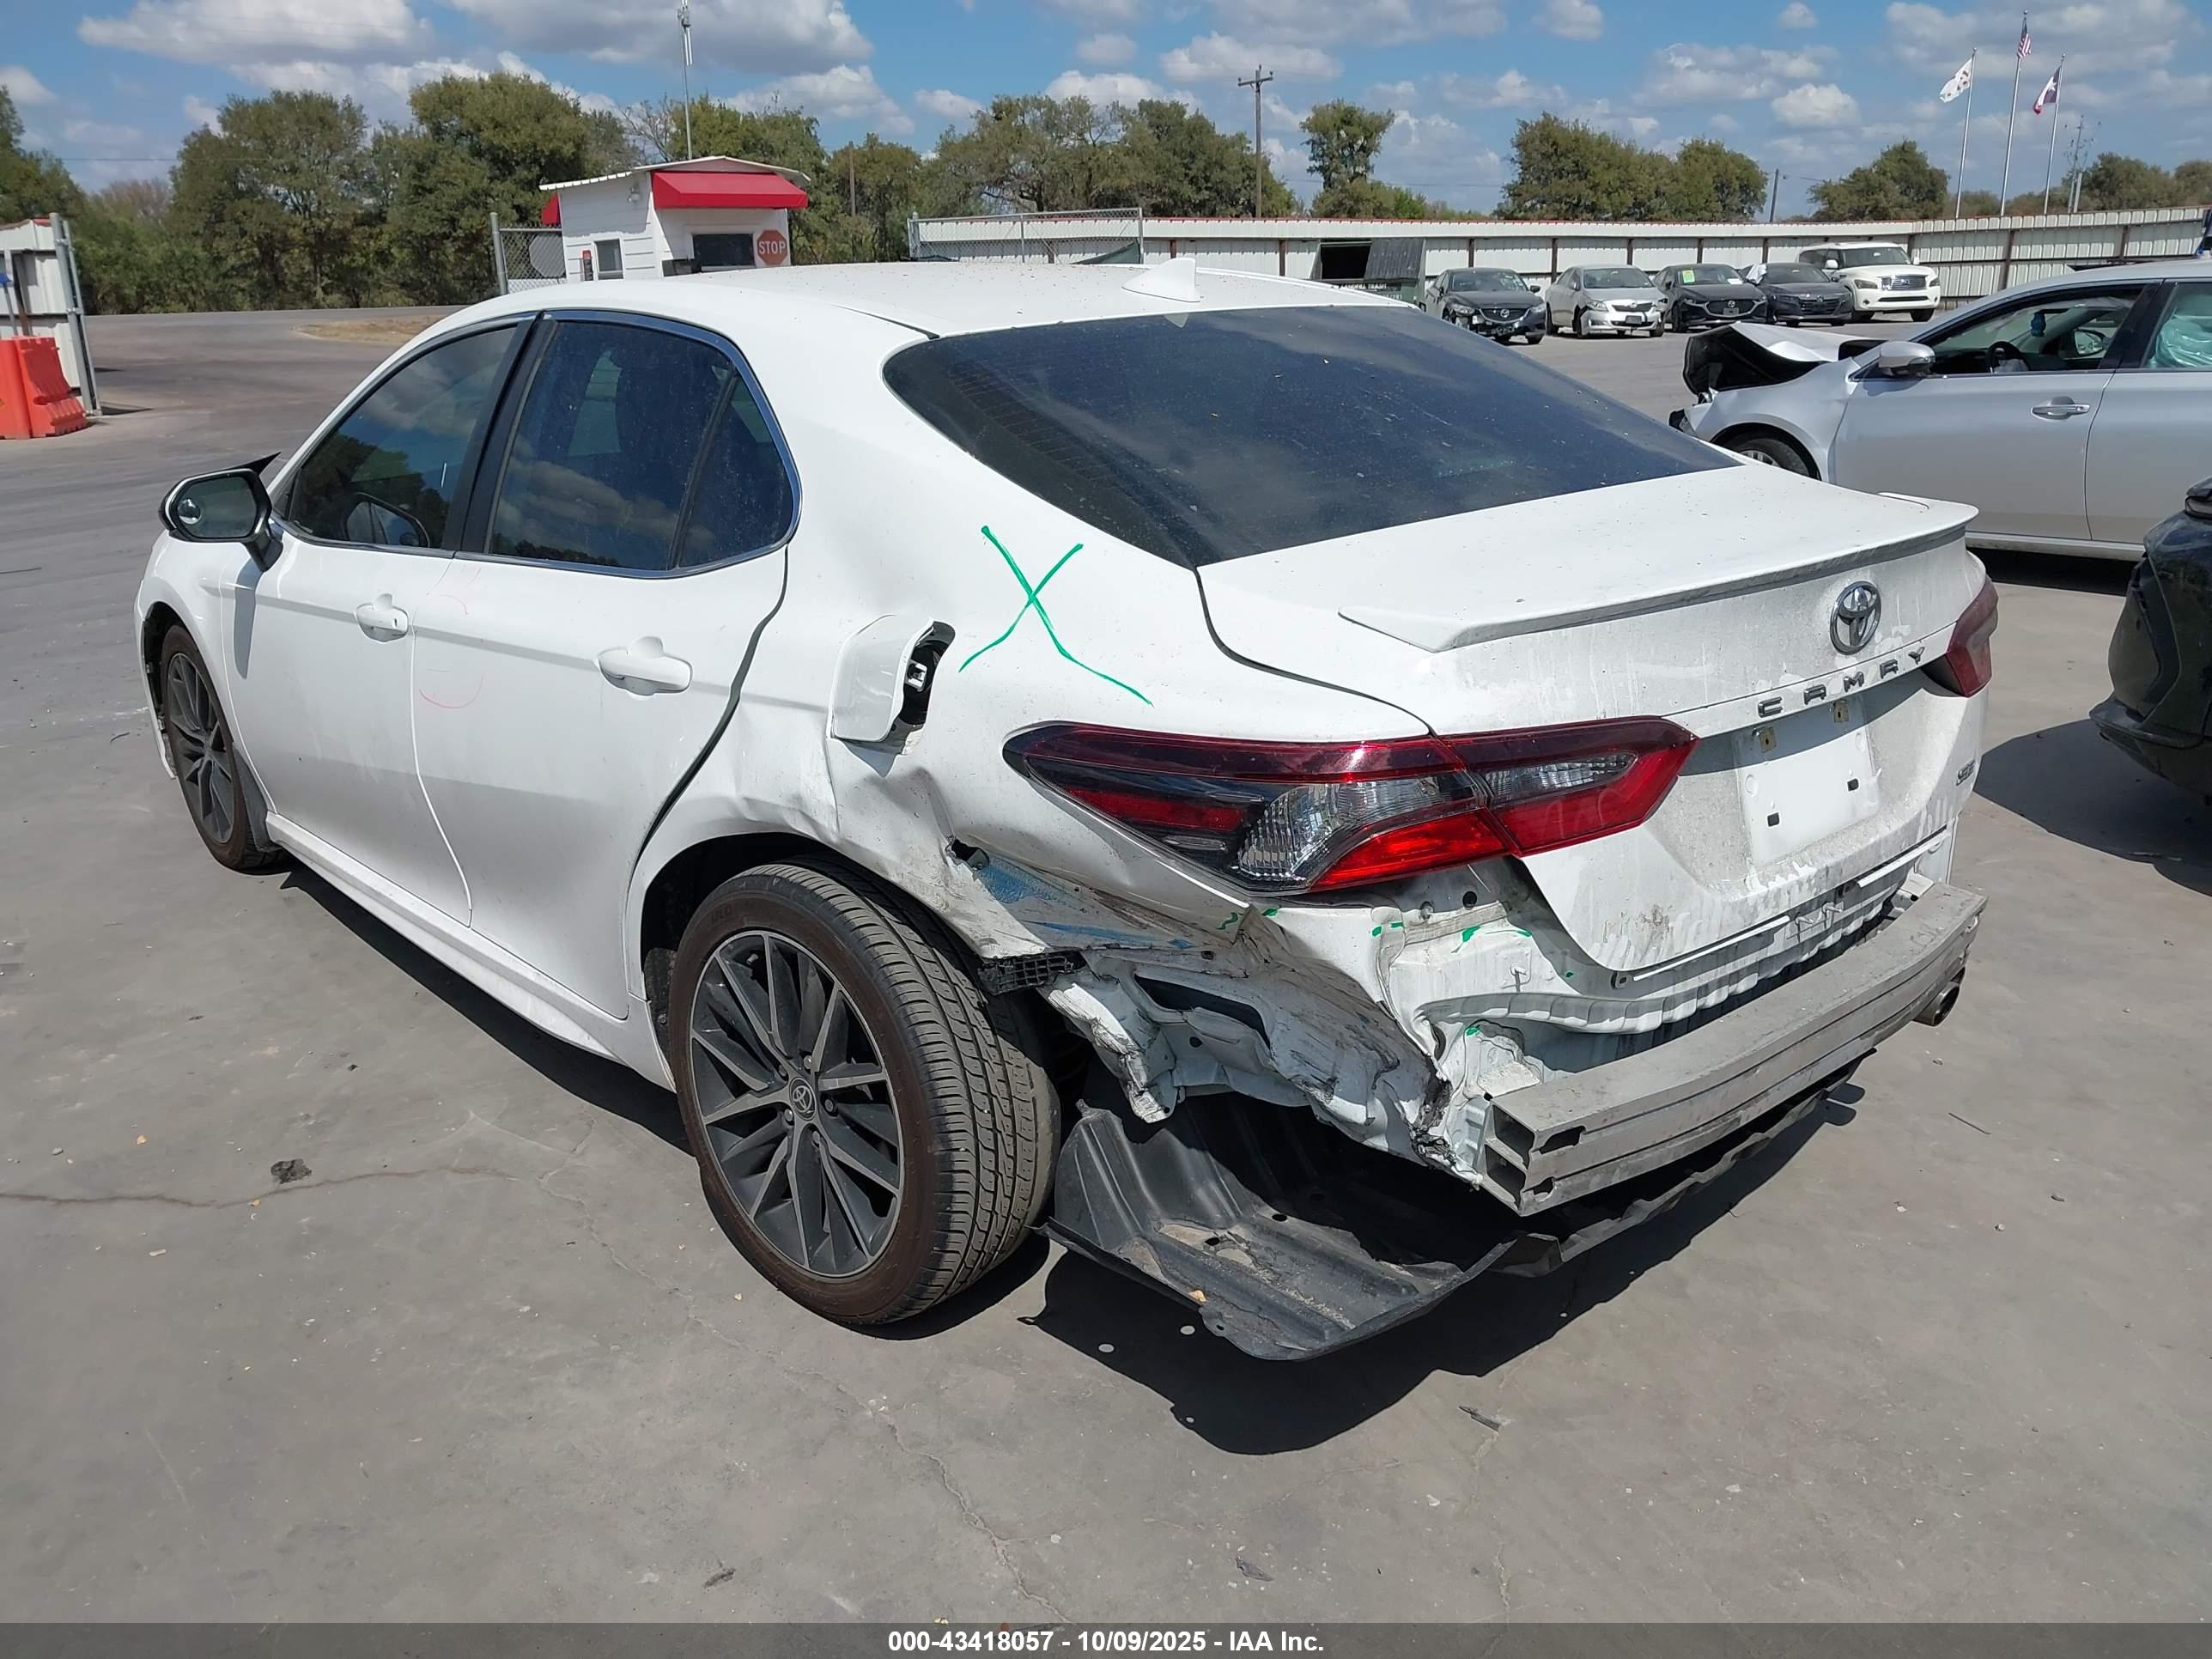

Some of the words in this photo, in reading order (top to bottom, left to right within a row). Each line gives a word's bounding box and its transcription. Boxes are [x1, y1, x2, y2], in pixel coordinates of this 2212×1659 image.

[758, 240, 786, 254] STOP
[1758, 647, 1925, 718] CAMRY
[1956, 760, 1975, 786] SE
